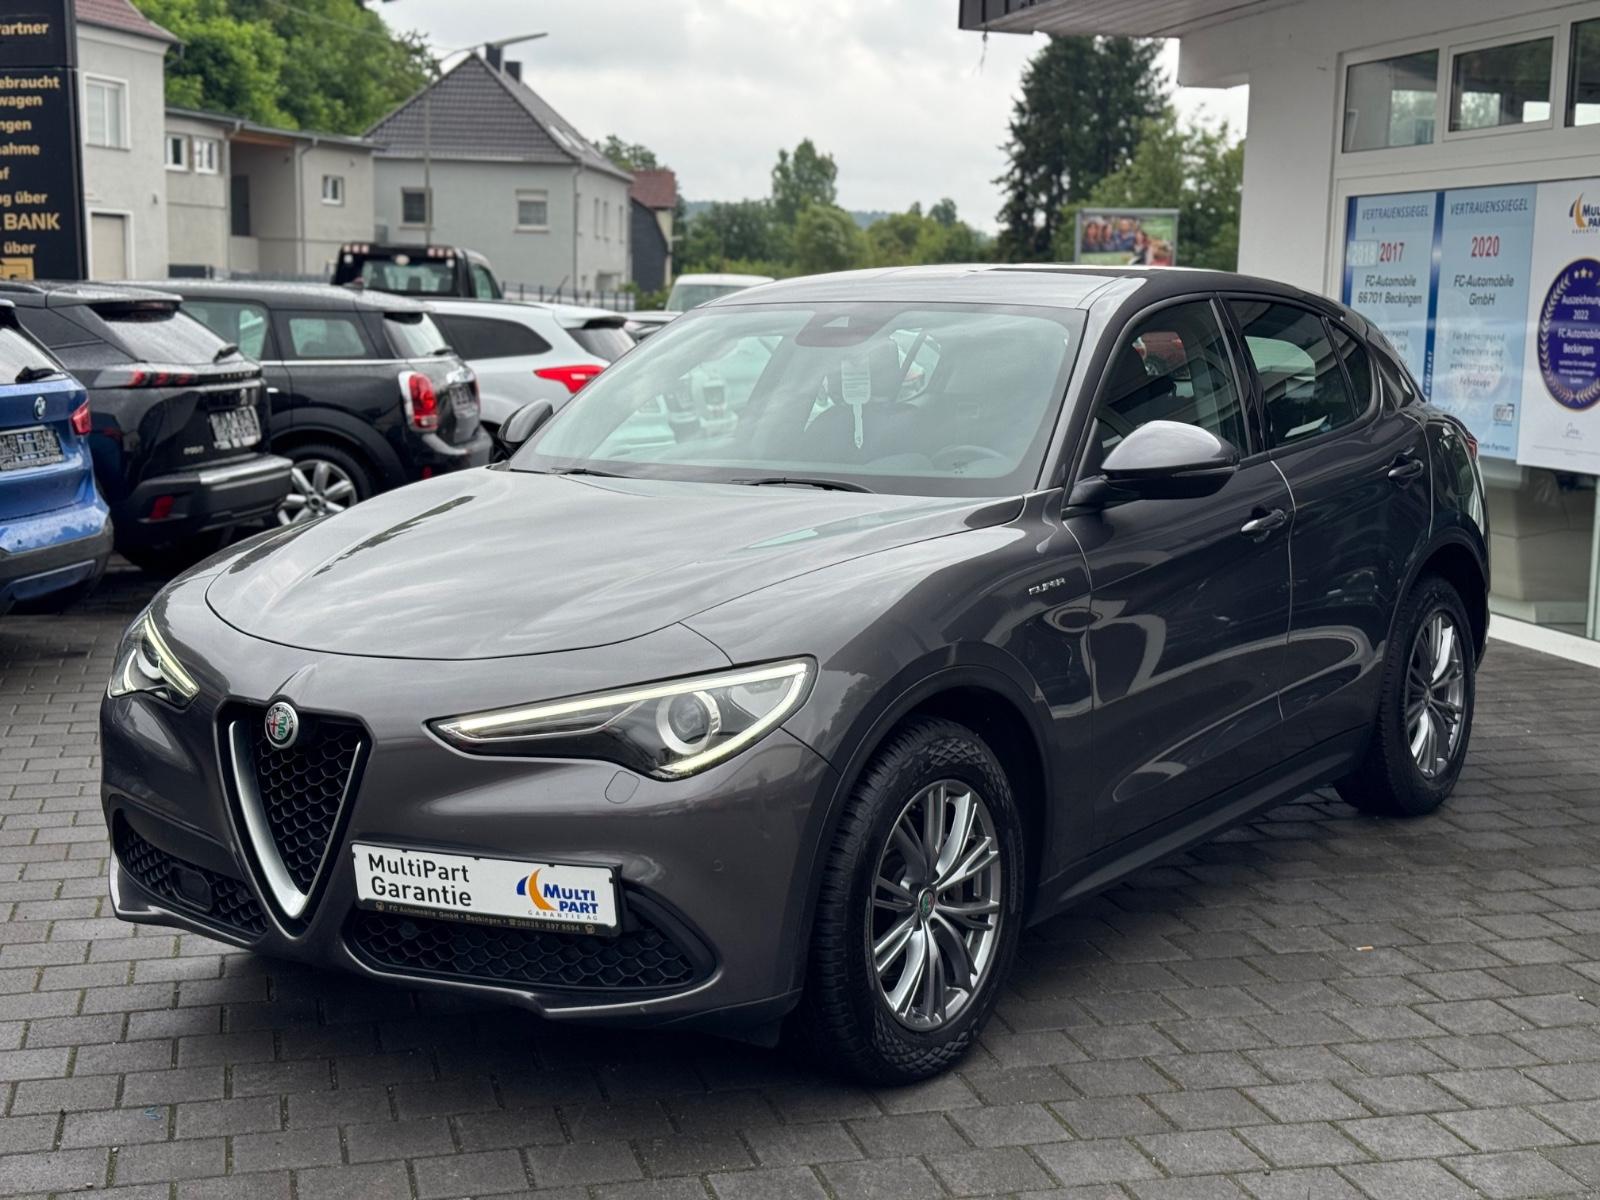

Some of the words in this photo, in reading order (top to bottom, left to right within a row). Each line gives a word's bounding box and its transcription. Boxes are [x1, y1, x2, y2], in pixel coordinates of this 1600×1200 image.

[0, 76, 60, 89] ebraucht
[0, 142, 41, 155] ahme
[14, 191, 48, 205] über
[1362, 205, 1429, 219] VERTRAUENSSIEGEL
[1450, 198, 1528, 215] VERTRAUENSSIEGEL
[3, 213, 61, 230] BANK
[3, 242, 36, 254] über
[1379, 242, 1405, 263] 2017
[1471, 235, 1500, 258] 2020
[1385, 290, 1423, 308] Beckingen
[1468, 292, 1496, 306] GmbH
[1573, 309, 1590, 321] 2022
[368, 853, 470, 883] MultiPart
[371, 875, 472, 907] Garantie
[559, 900, 599, 915] PART
